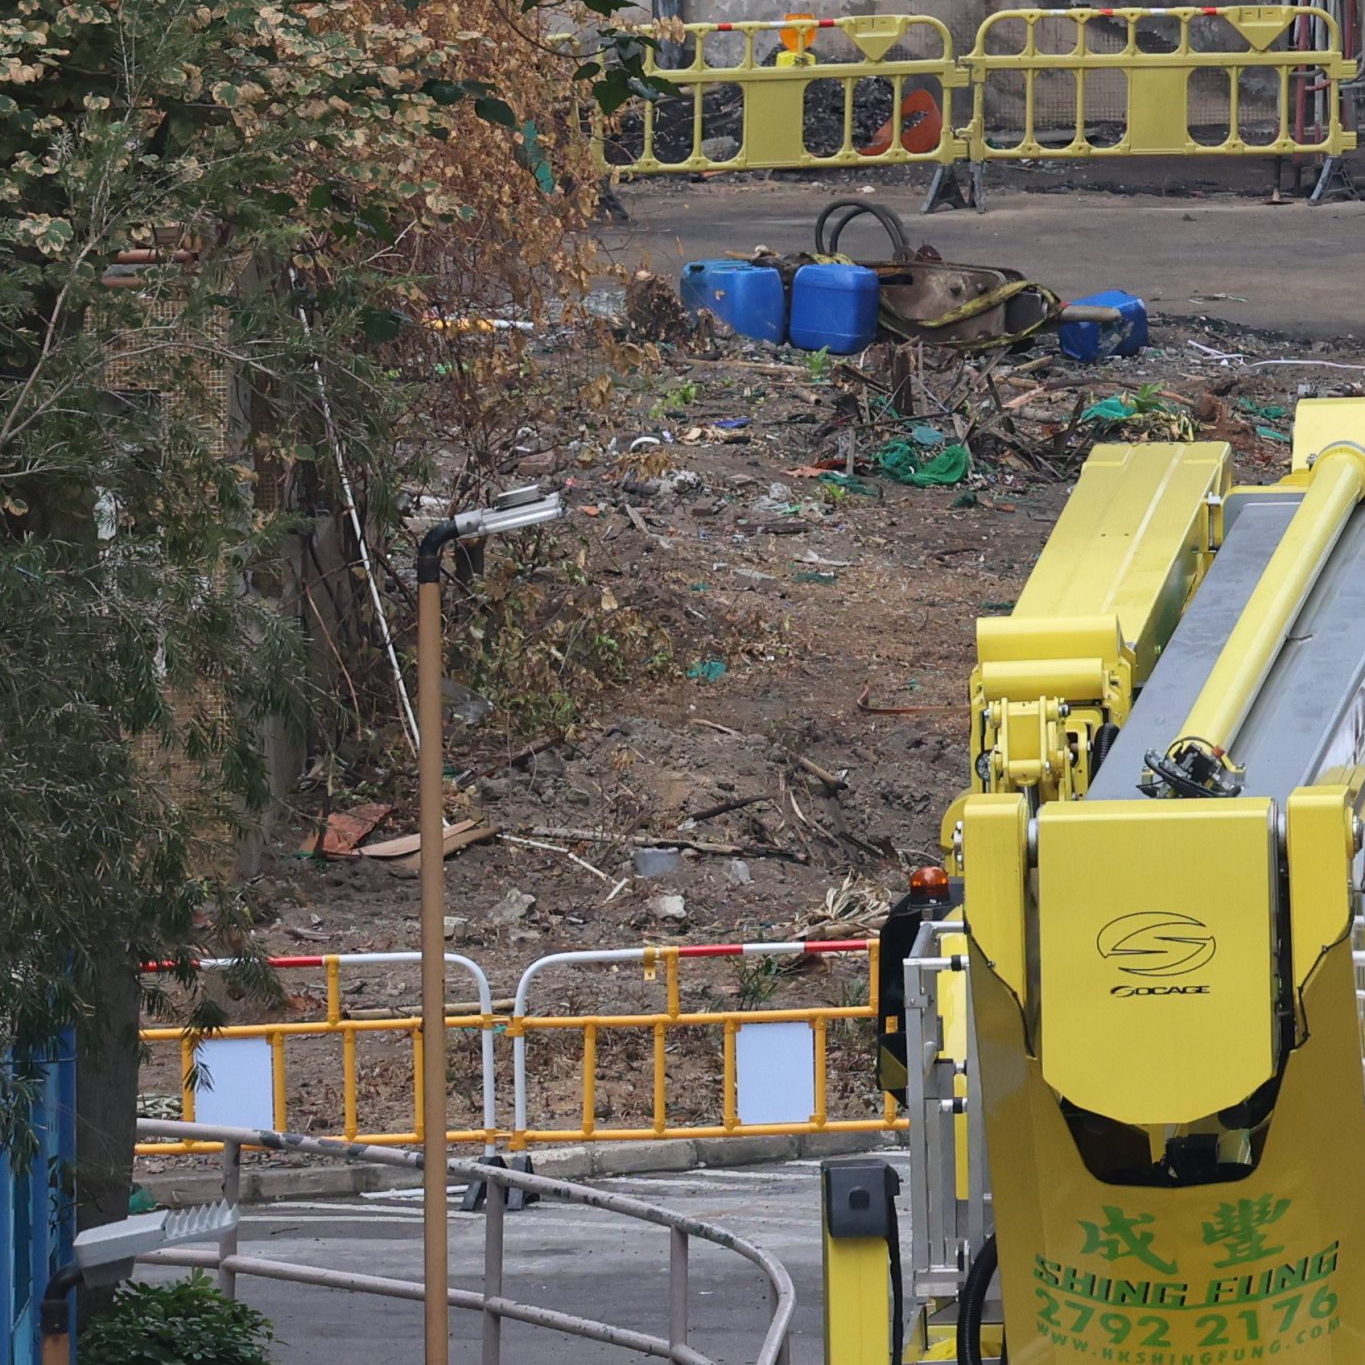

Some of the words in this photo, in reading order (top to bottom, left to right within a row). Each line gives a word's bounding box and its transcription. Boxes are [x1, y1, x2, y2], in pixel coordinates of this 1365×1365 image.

[1110, 985, 1211, 998] SOCAGE
[1033, 1253, 1189, 1308] SHING
[1205, 1240, 1339, 1306] FUNG
[1034, 1288, 1172, 1347] 2792
[1195, 1284, 1339, 1347] 2176
[1036, 1315, 1341, 1365] WWW.HKSHINGFUNG.COM
